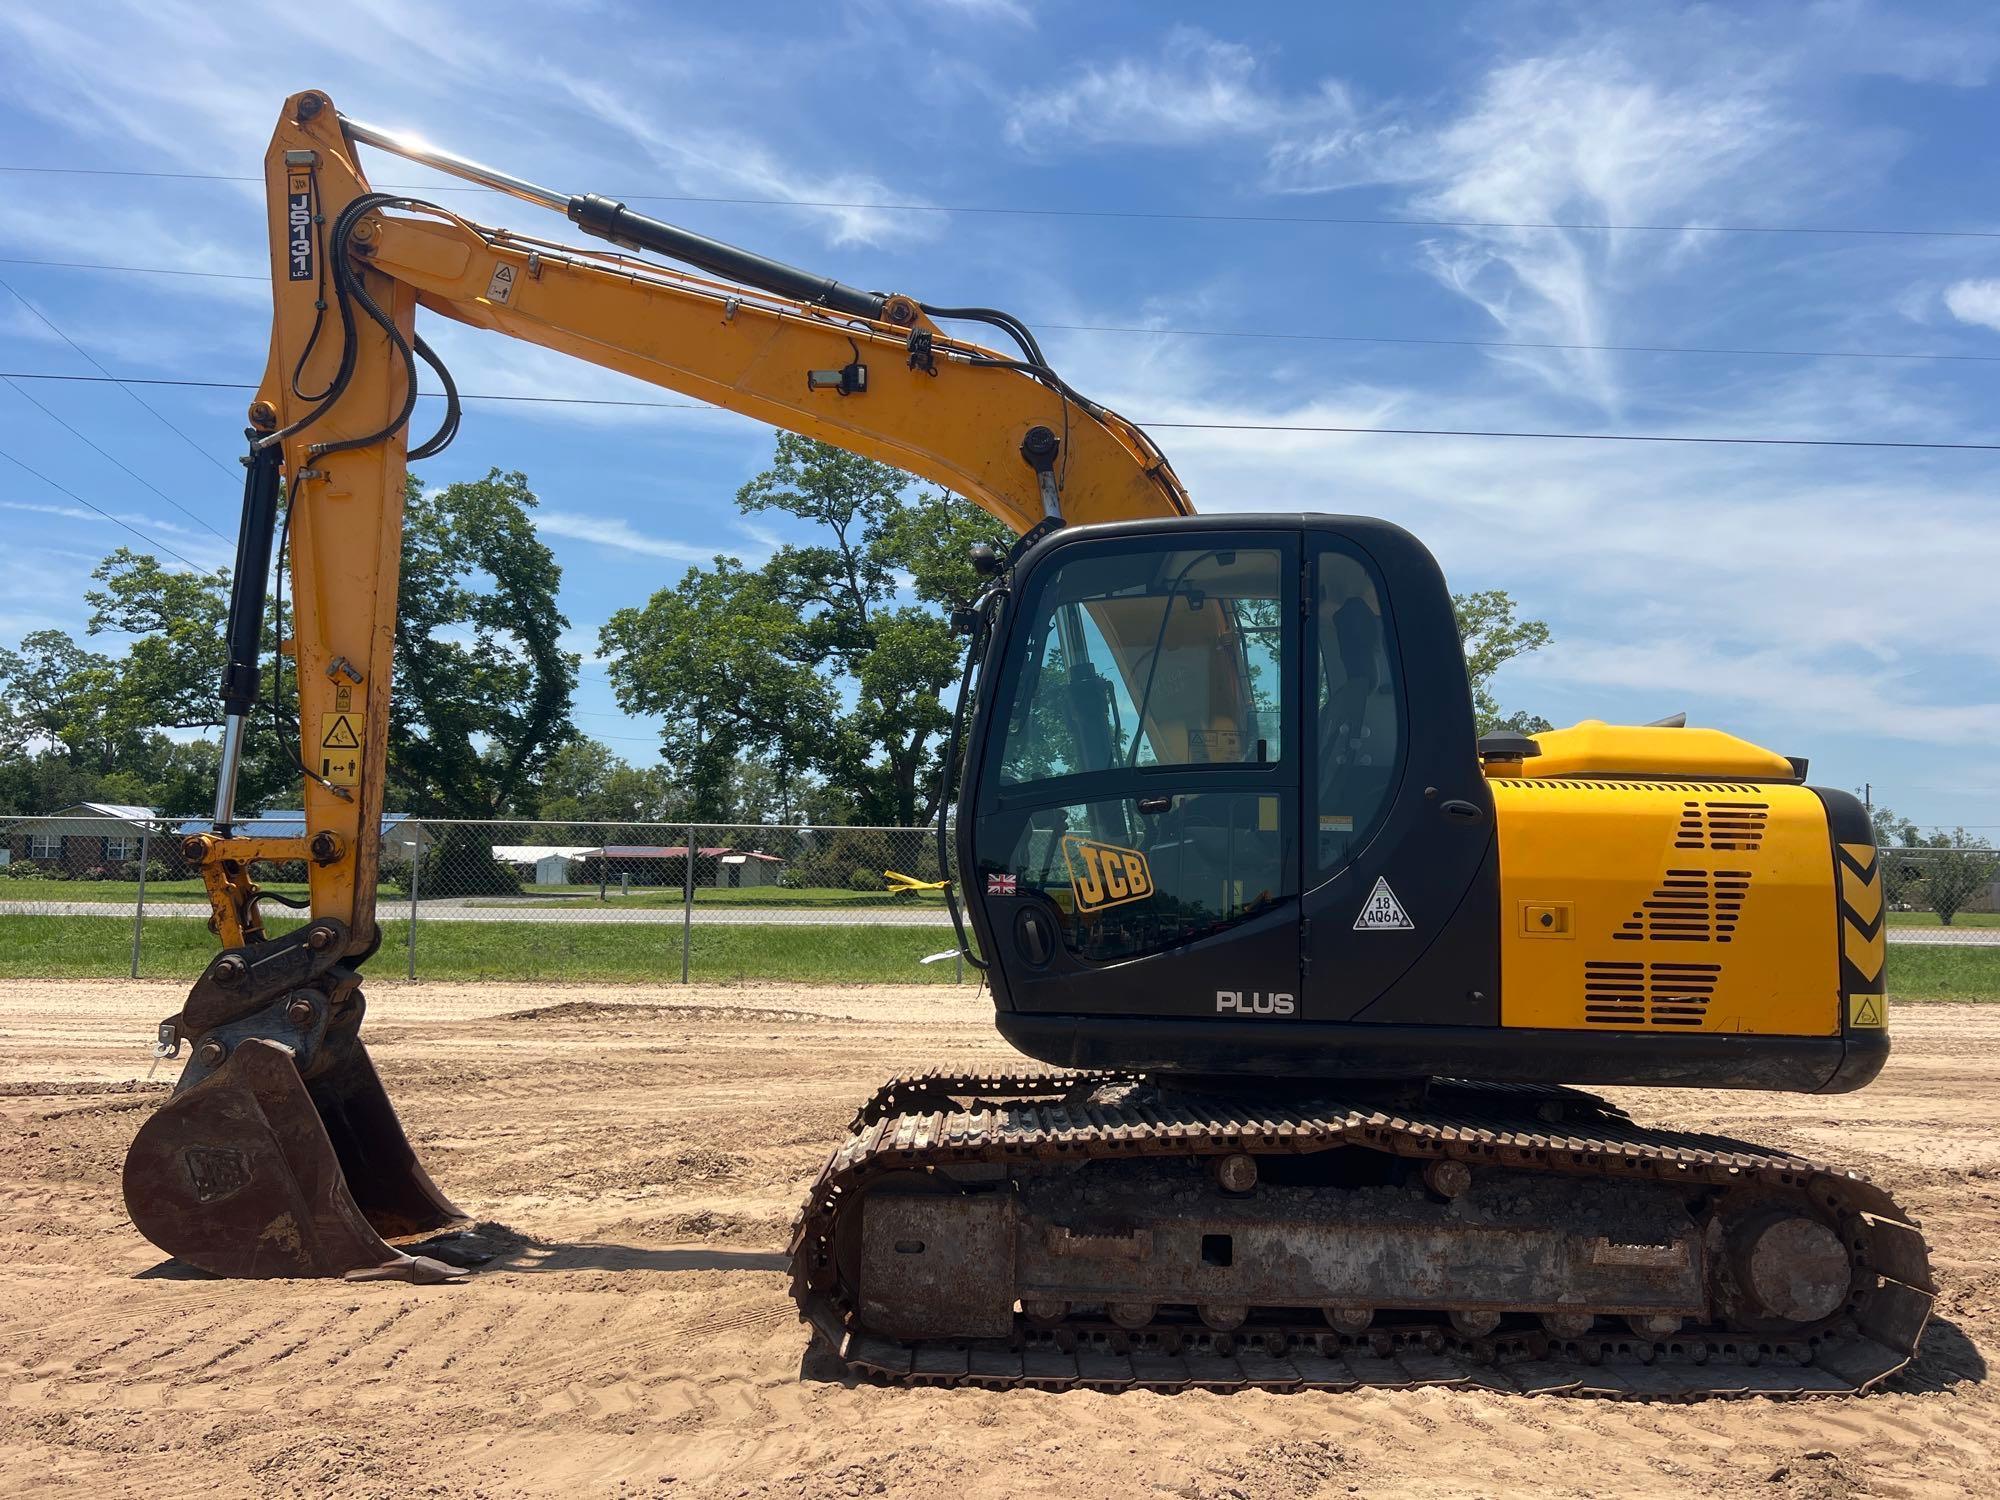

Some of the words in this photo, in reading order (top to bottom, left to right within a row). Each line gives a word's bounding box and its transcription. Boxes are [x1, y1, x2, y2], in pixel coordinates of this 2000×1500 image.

[290, 195, 310, 270] JS131
[1078, 847, 1147, 904] JCB
[1375, 897, 1390, 909] 18
[1368, 911, 1400, 922] AQ6A
[1216, 991, 1294, 1014] PLUS
